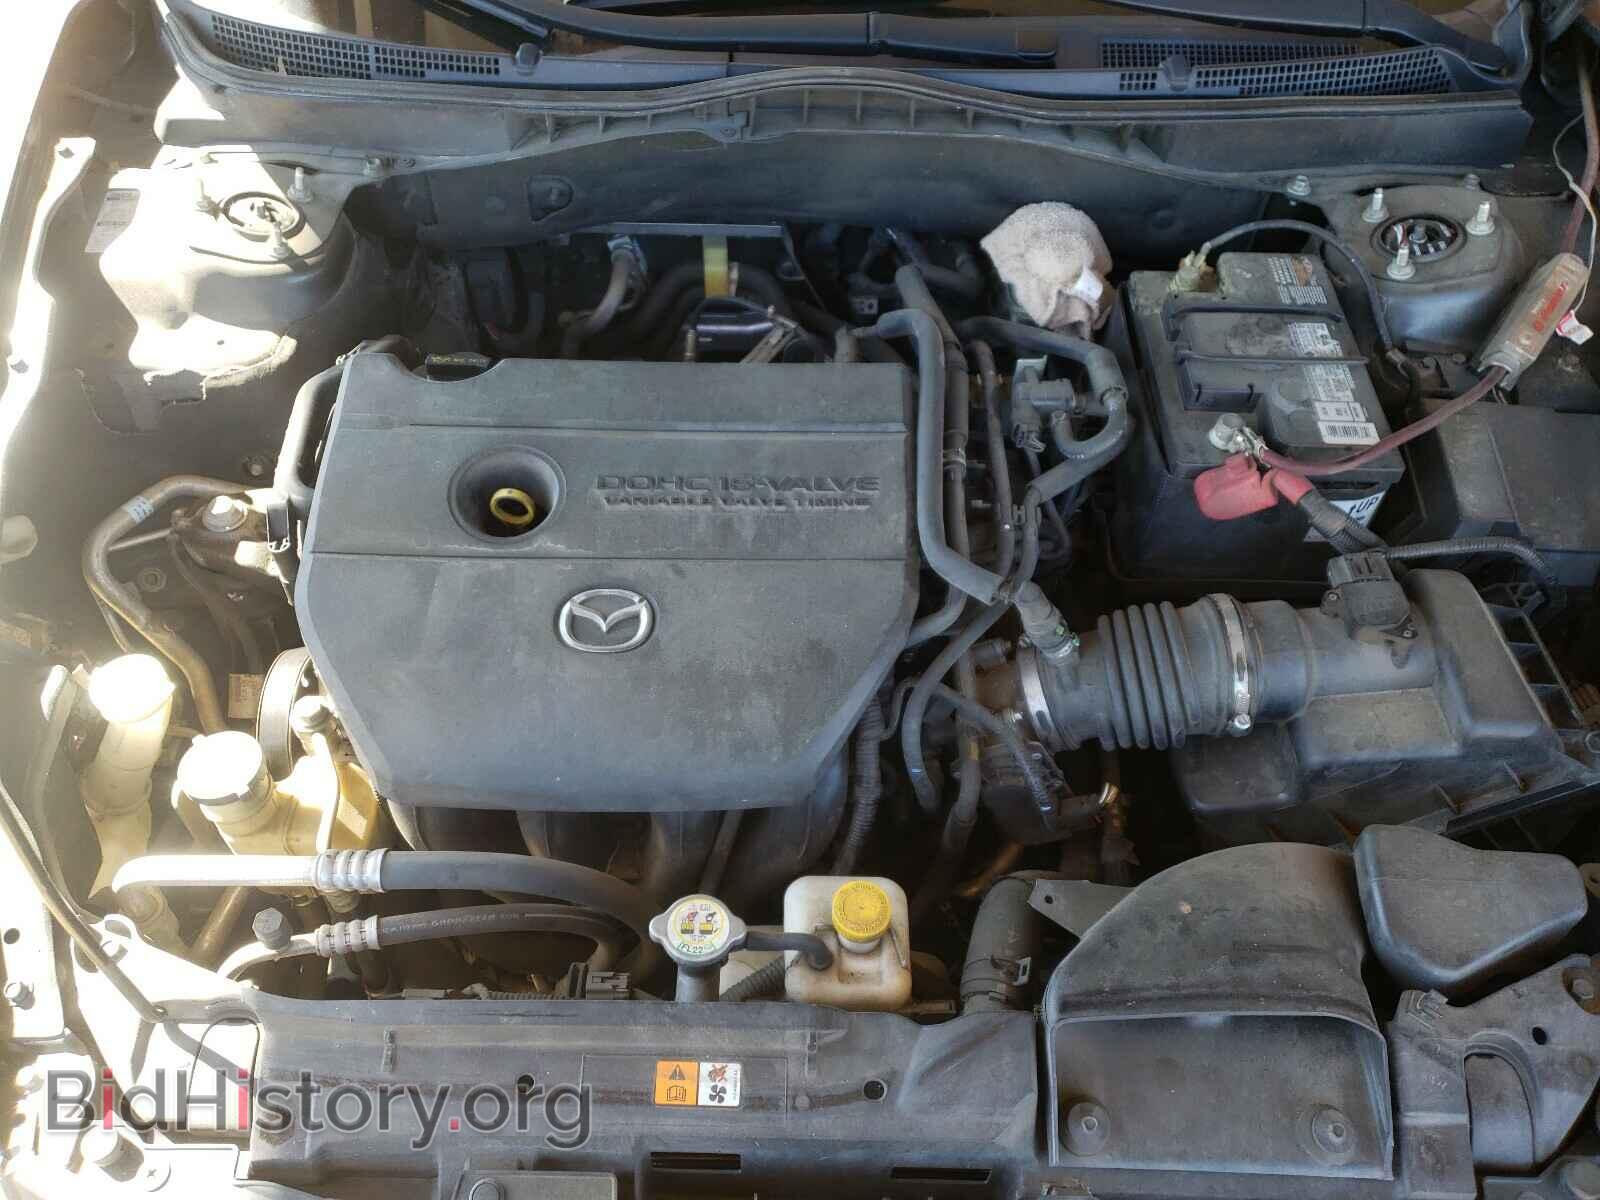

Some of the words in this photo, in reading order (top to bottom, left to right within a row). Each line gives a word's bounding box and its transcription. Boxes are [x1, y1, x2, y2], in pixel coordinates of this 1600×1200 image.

[597, 475, 712, 492] DOHC
[719, 475, 880, 493] 16-VALVE
[602, 496, 713, 511] VARIABLE
